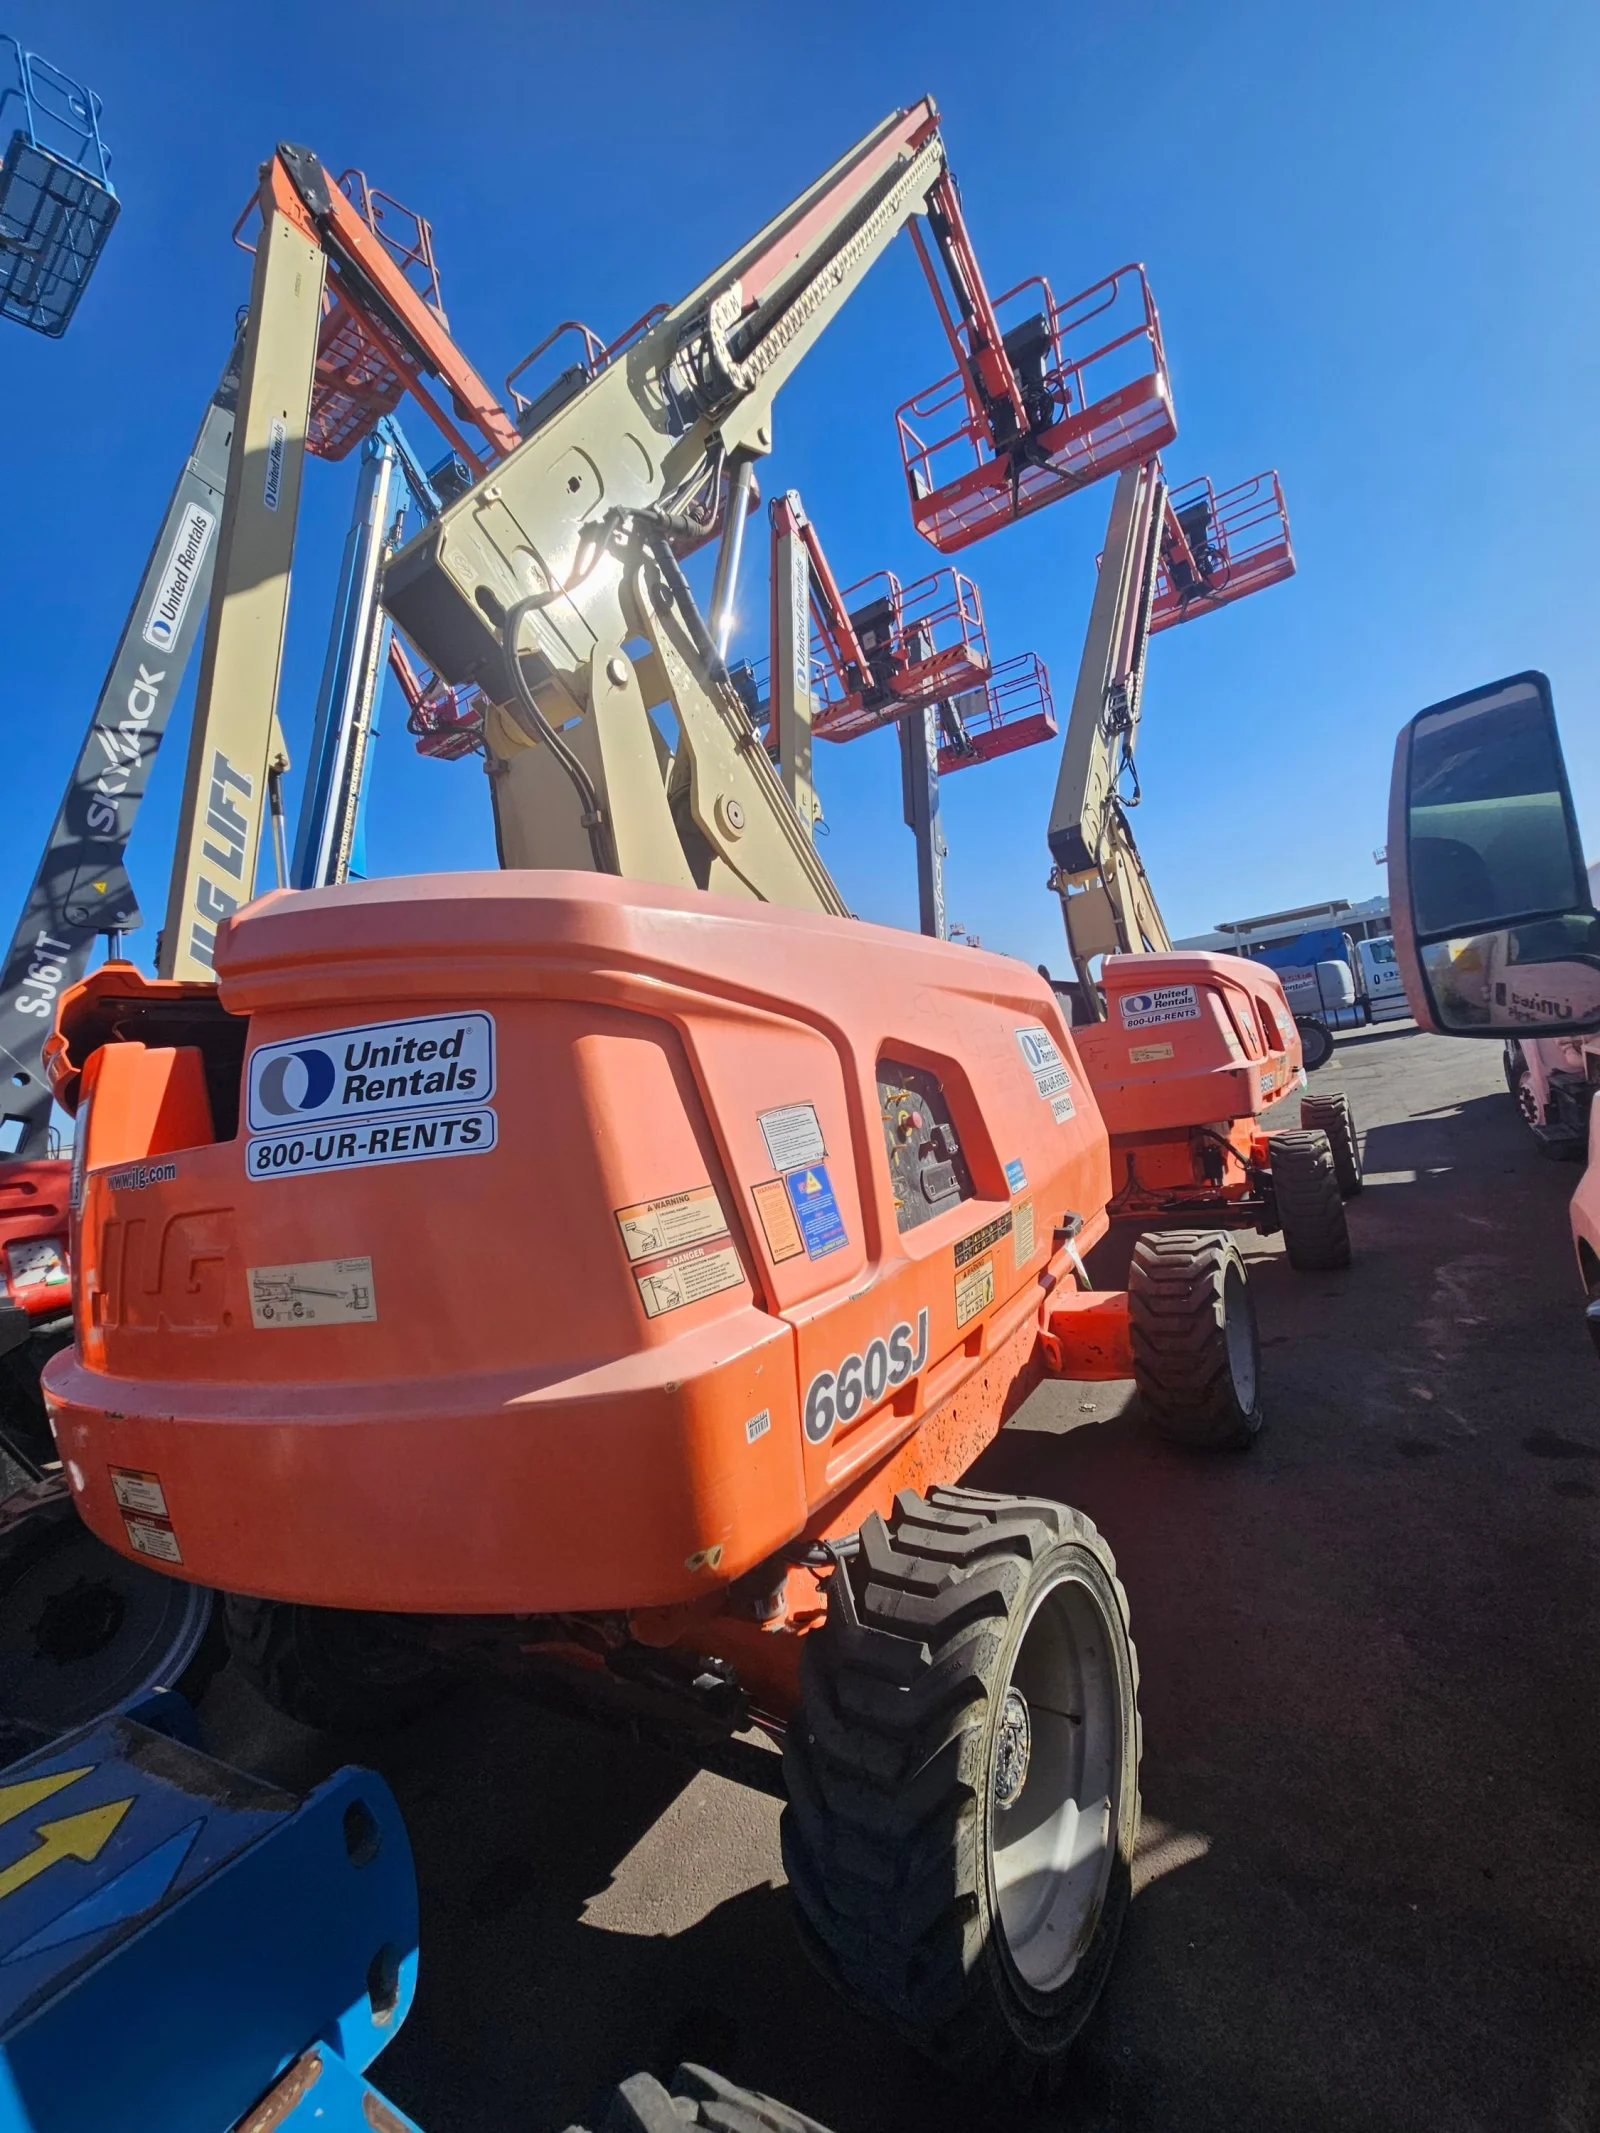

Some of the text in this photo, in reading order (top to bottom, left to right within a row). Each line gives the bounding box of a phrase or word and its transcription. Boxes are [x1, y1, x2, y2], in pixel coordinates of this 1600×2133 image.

[267, 424, 284, 494] United Rentals
[159, 515, 207, 621] United Rentals
[795, 557, 806, 667] United Rentals
[86, 663, 166, 833] SKYJACK
[201, 747, 253, 882] LIFT
[15, 930, 71, 1018] SJ61T
[1153, 988, 1188, 1001] United
[1127, 1008, 1197, 1028] 800-UR-RENTS
[1154, 995, 1193, 1009] Rentals
[344, 1028, 465, 1072] United
[342, 1062, 477, 1105] Rentals
[256, 1117, 483, 1170] 800-UR-RENTS
[107, 1162, 177, 1191] www.jlg.com
[653, 1194, 690, 1211] WARNING
[670, 1248, 705, 1264] DANGER
[804, 1306, 929, 1445] 660SJ
